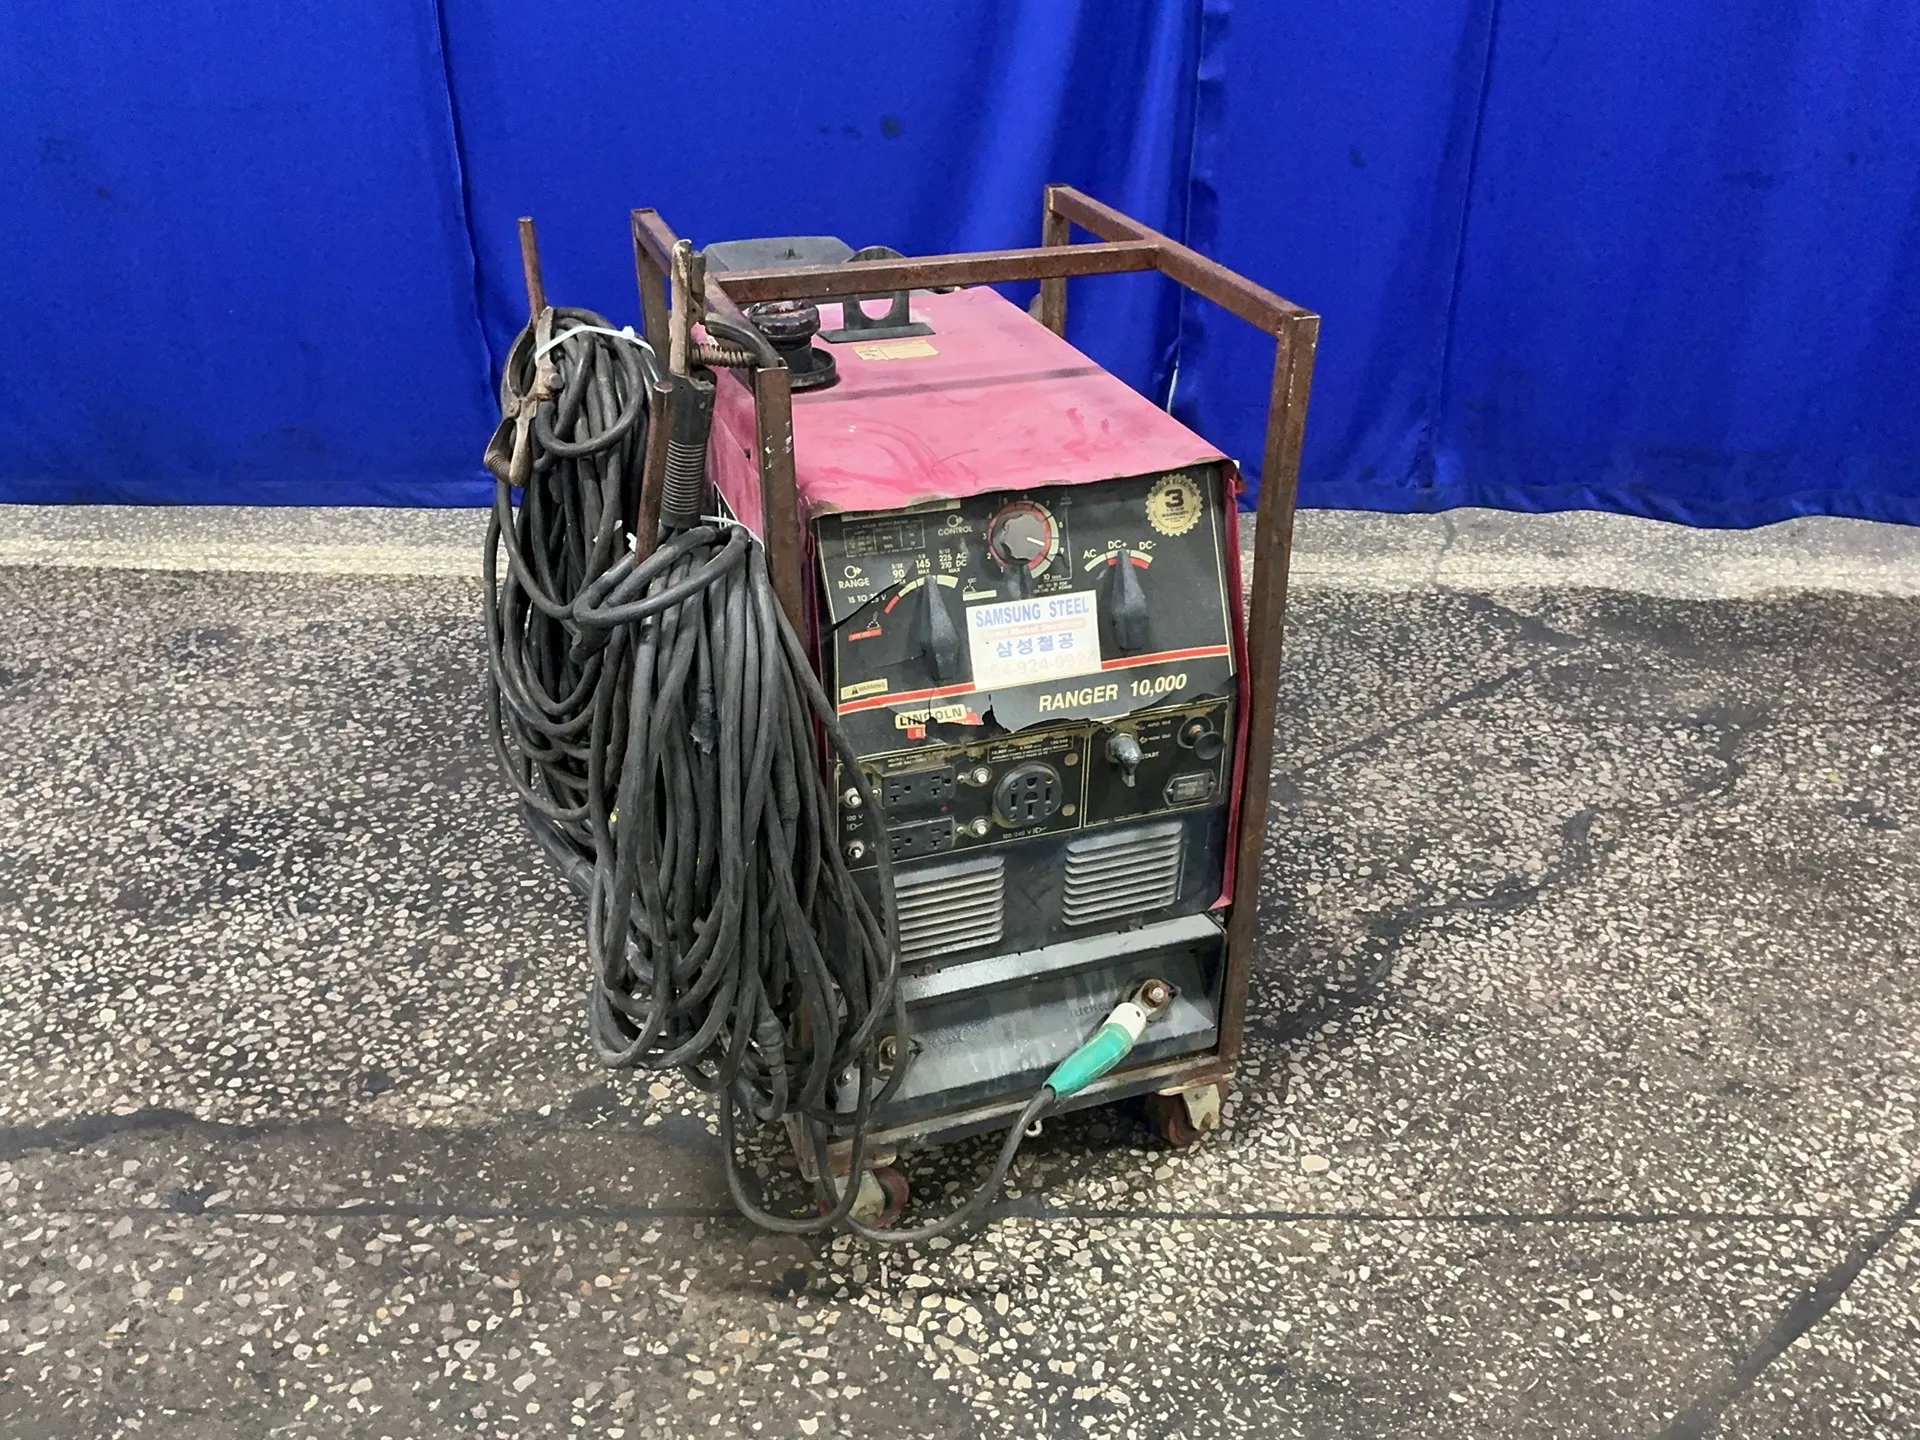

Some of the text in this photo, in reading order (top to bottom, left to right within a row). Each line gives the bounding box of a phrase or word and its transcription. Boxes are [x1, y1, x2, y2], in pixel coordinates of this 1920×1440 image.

[1165, 489, 1184, 508] 3
[938, 526, 973, 536] CONTROL
[1108, 540, 1127, 550] DC+
[1139, 540, 1157, 551] DC-
[938, 552, 968, 562] 225 AC
[1083, 549, 1097, 559] AC
[915, 559, 931, 569] 145
[940, 559, 967, 569] 210 DC
[892, 569, 905, 578] 90
[838, 577, 870, 589] RANGE
[848, 596, 856, 604] 15
[975, 597, 1090, 628] SAMSUNG STEEL
[996, 632, 1074, 658] 삼성철공
[1039, 674, 1188, 712] RANGER 10,000
